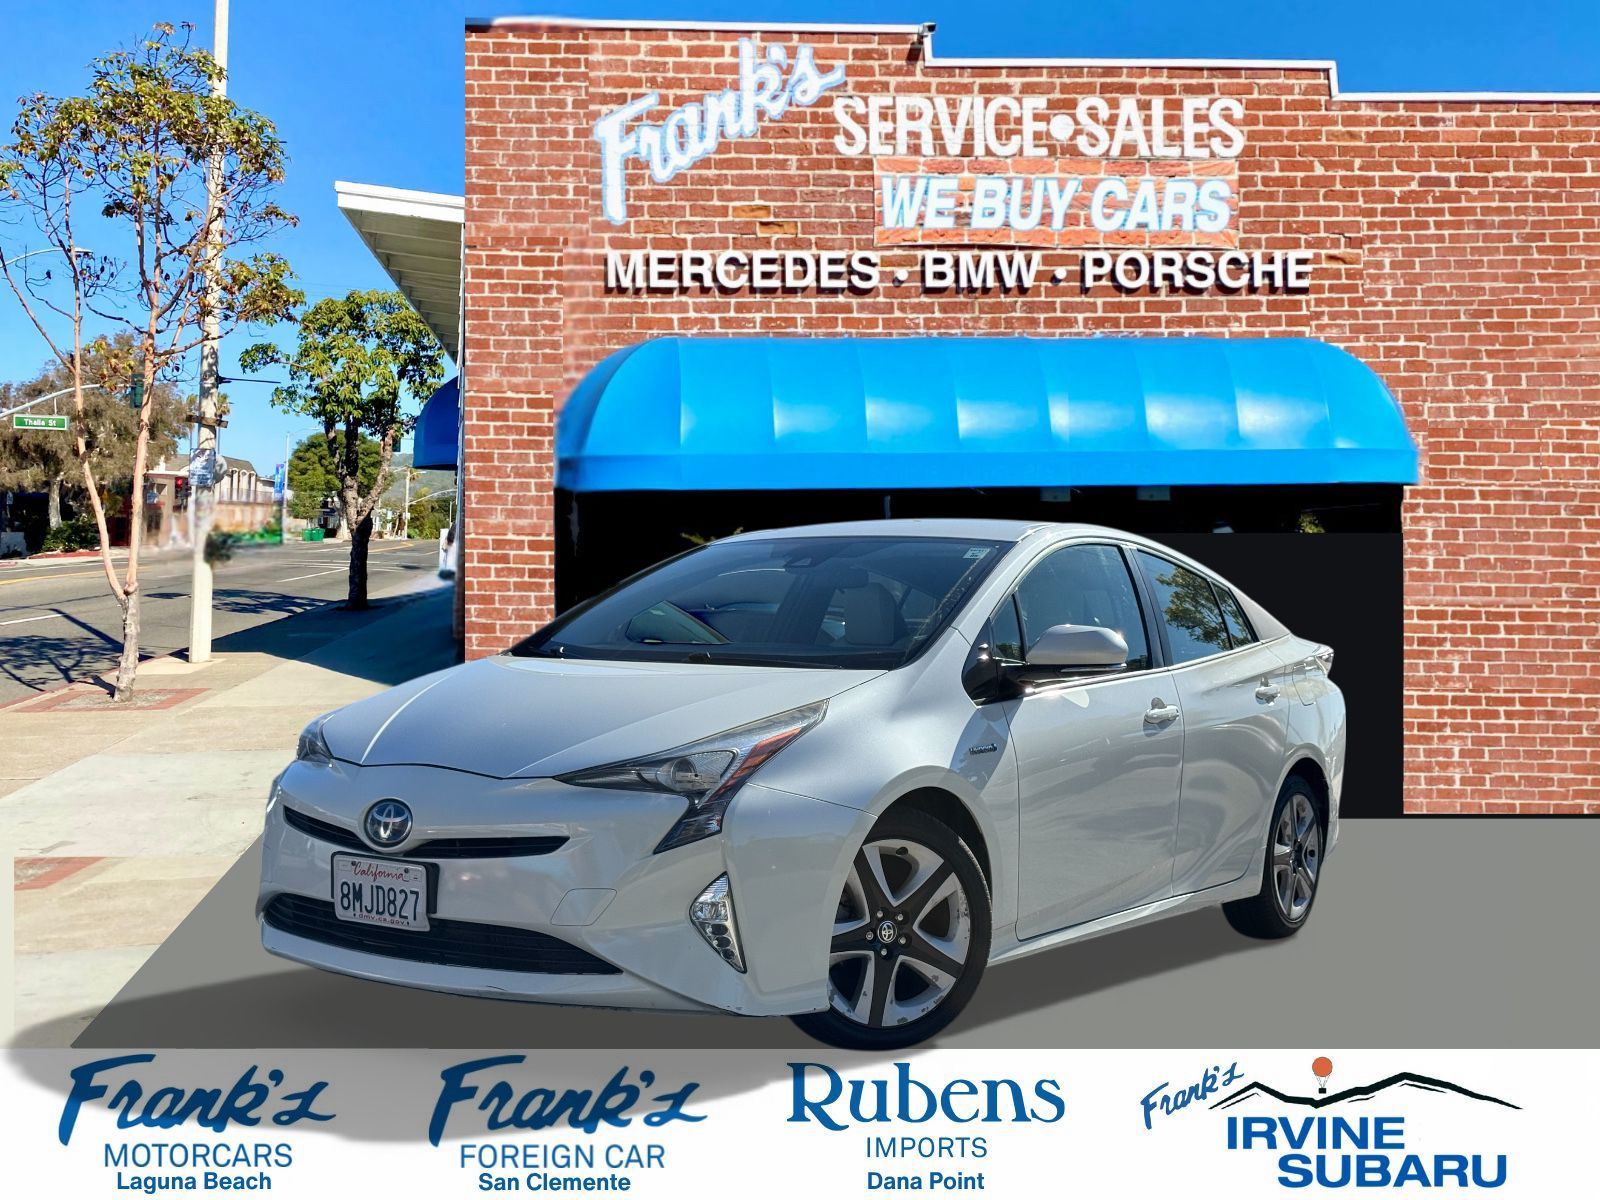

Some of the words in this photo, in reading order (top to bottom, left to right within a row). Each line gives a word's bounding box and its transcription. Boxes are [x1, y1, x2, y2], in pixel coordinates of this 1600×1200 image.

[593, 37, 846, 226] Frank's
[833, 95, 1049, 157] SERVICE
[1075, 97, 1245, 157] SALES
[881, 175, 960, 229] WE
[970, 176, 1083, 231] BUY
[1090, 177, 1233, 232] CARS
[606, 251, 881, 290] MERCEDES
[925, 251, 1041, 289] BMW
[1084, 251, 1314, 289] PORSCHE
[24, 418, 46, 426] Thalia
[48, 419, 57, 427] St
[354, 861, 409, 882] California
[340, 881, 420, 921] 8MJD827
